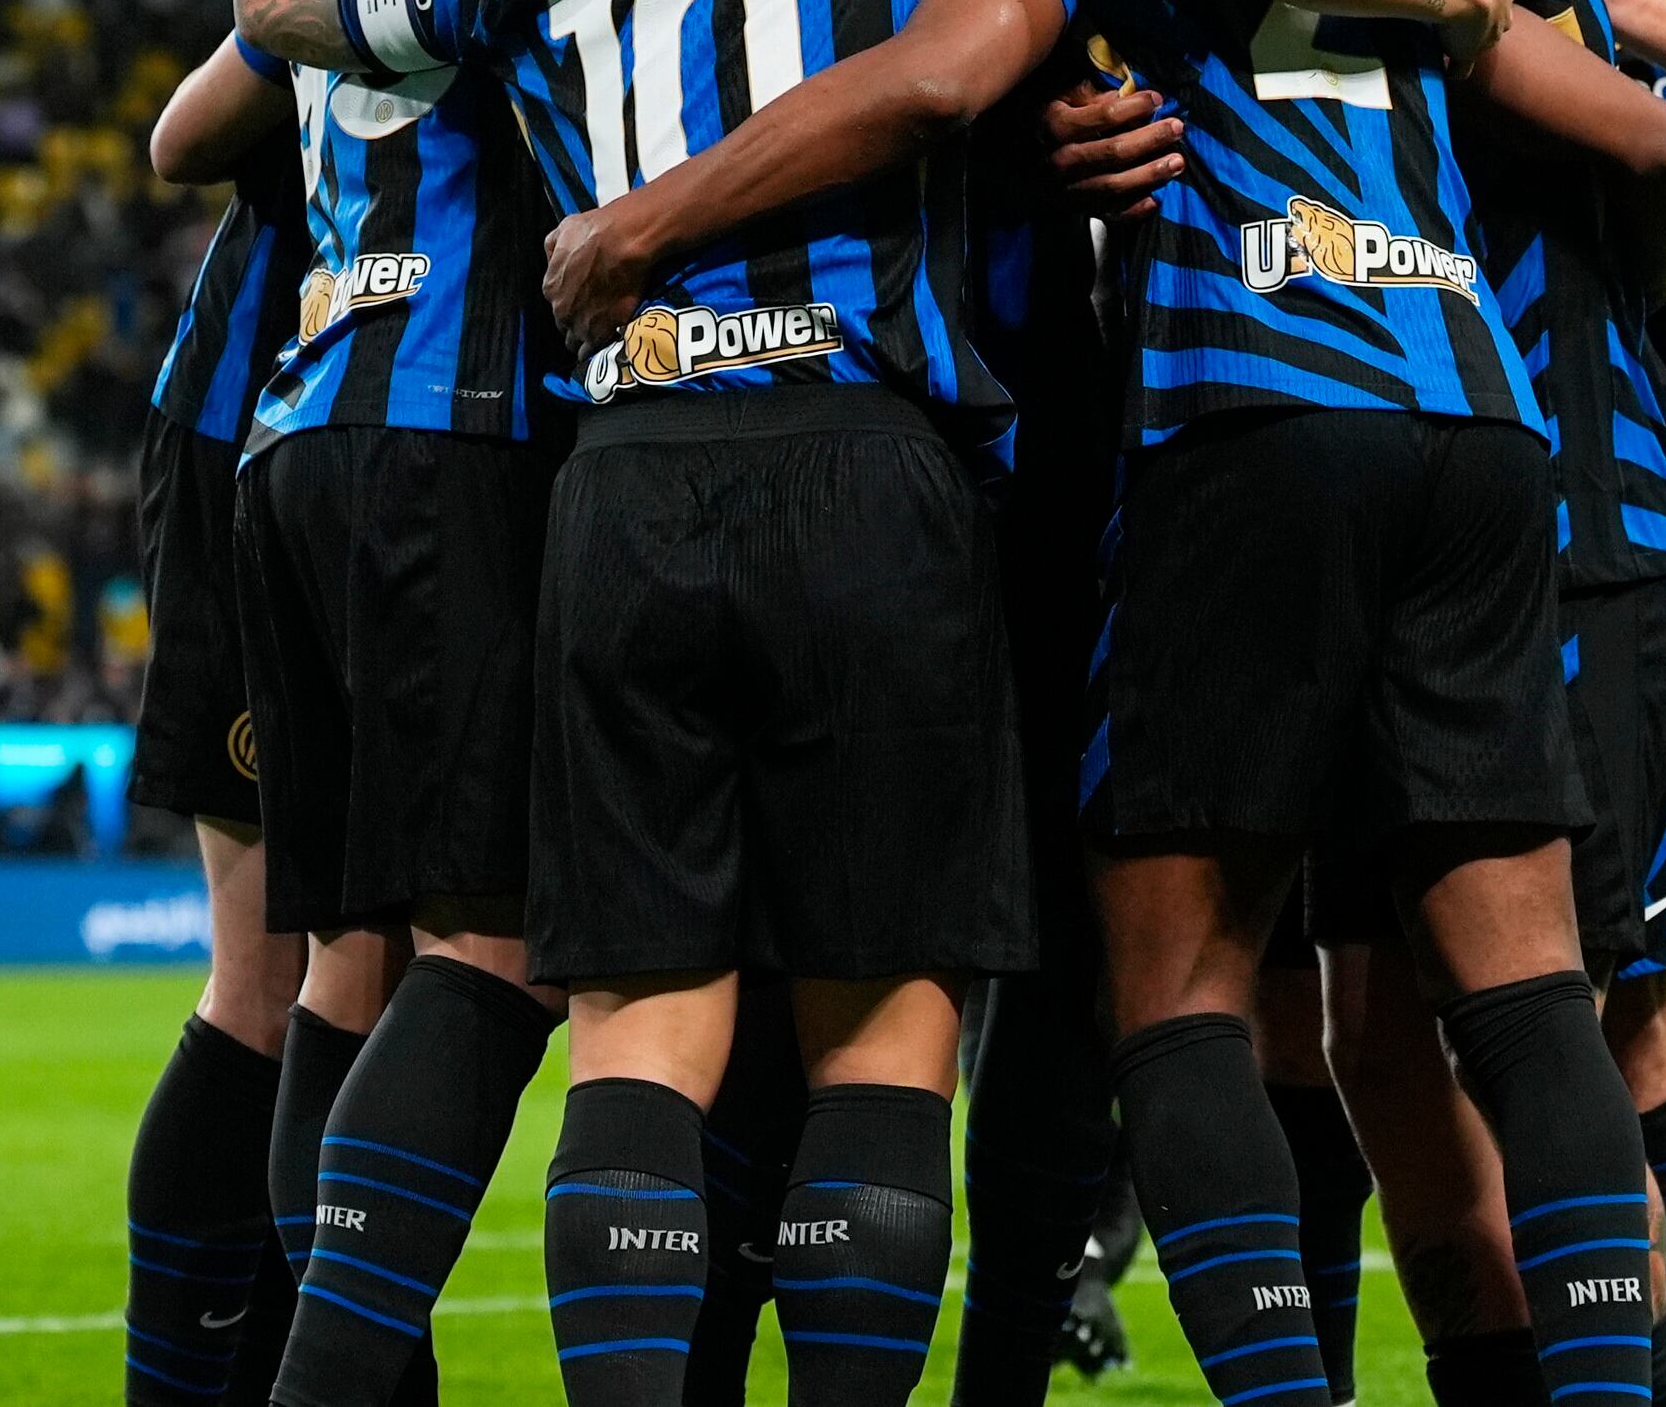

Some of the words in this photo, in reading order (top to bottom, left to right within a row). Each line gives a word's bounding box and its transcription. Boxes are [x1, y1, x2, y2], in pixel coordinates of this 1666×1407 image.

[1354, 223, 1474, 290] Power
[677, 306, 835, 374] Power
[608, 1226, 700, 1254] INTER
[777, 1219, 850, 1246] INTER
[1252, 1285, 1311, 1311] INTER
[1566, 1276, 1643, 1308] INTER
